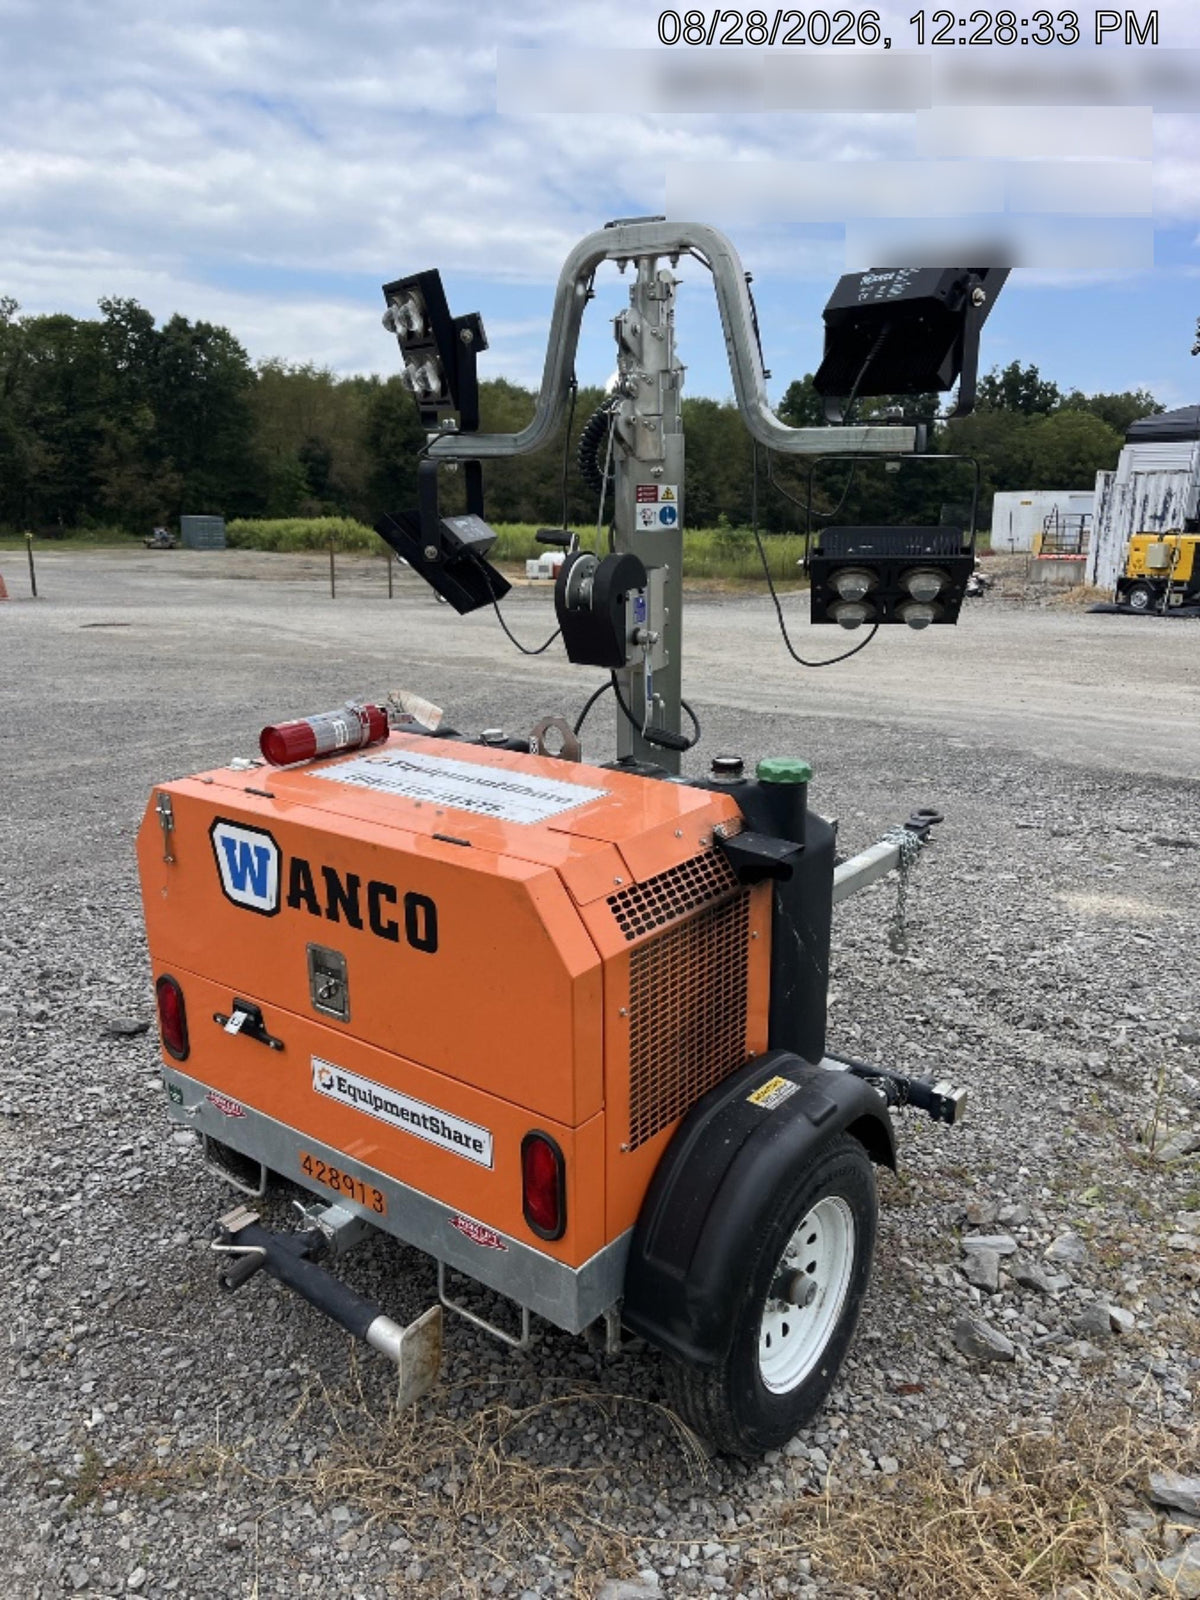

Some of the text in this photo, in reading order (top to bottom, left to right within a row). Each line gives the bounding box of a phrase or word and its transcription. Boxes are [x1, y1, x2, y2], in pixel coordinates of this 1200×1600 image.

[220, 835, 438, 954] WANCO
[336, 1075, 484, 1154] EquipmentShare
[302, 1155, 384, 1213] 428913
